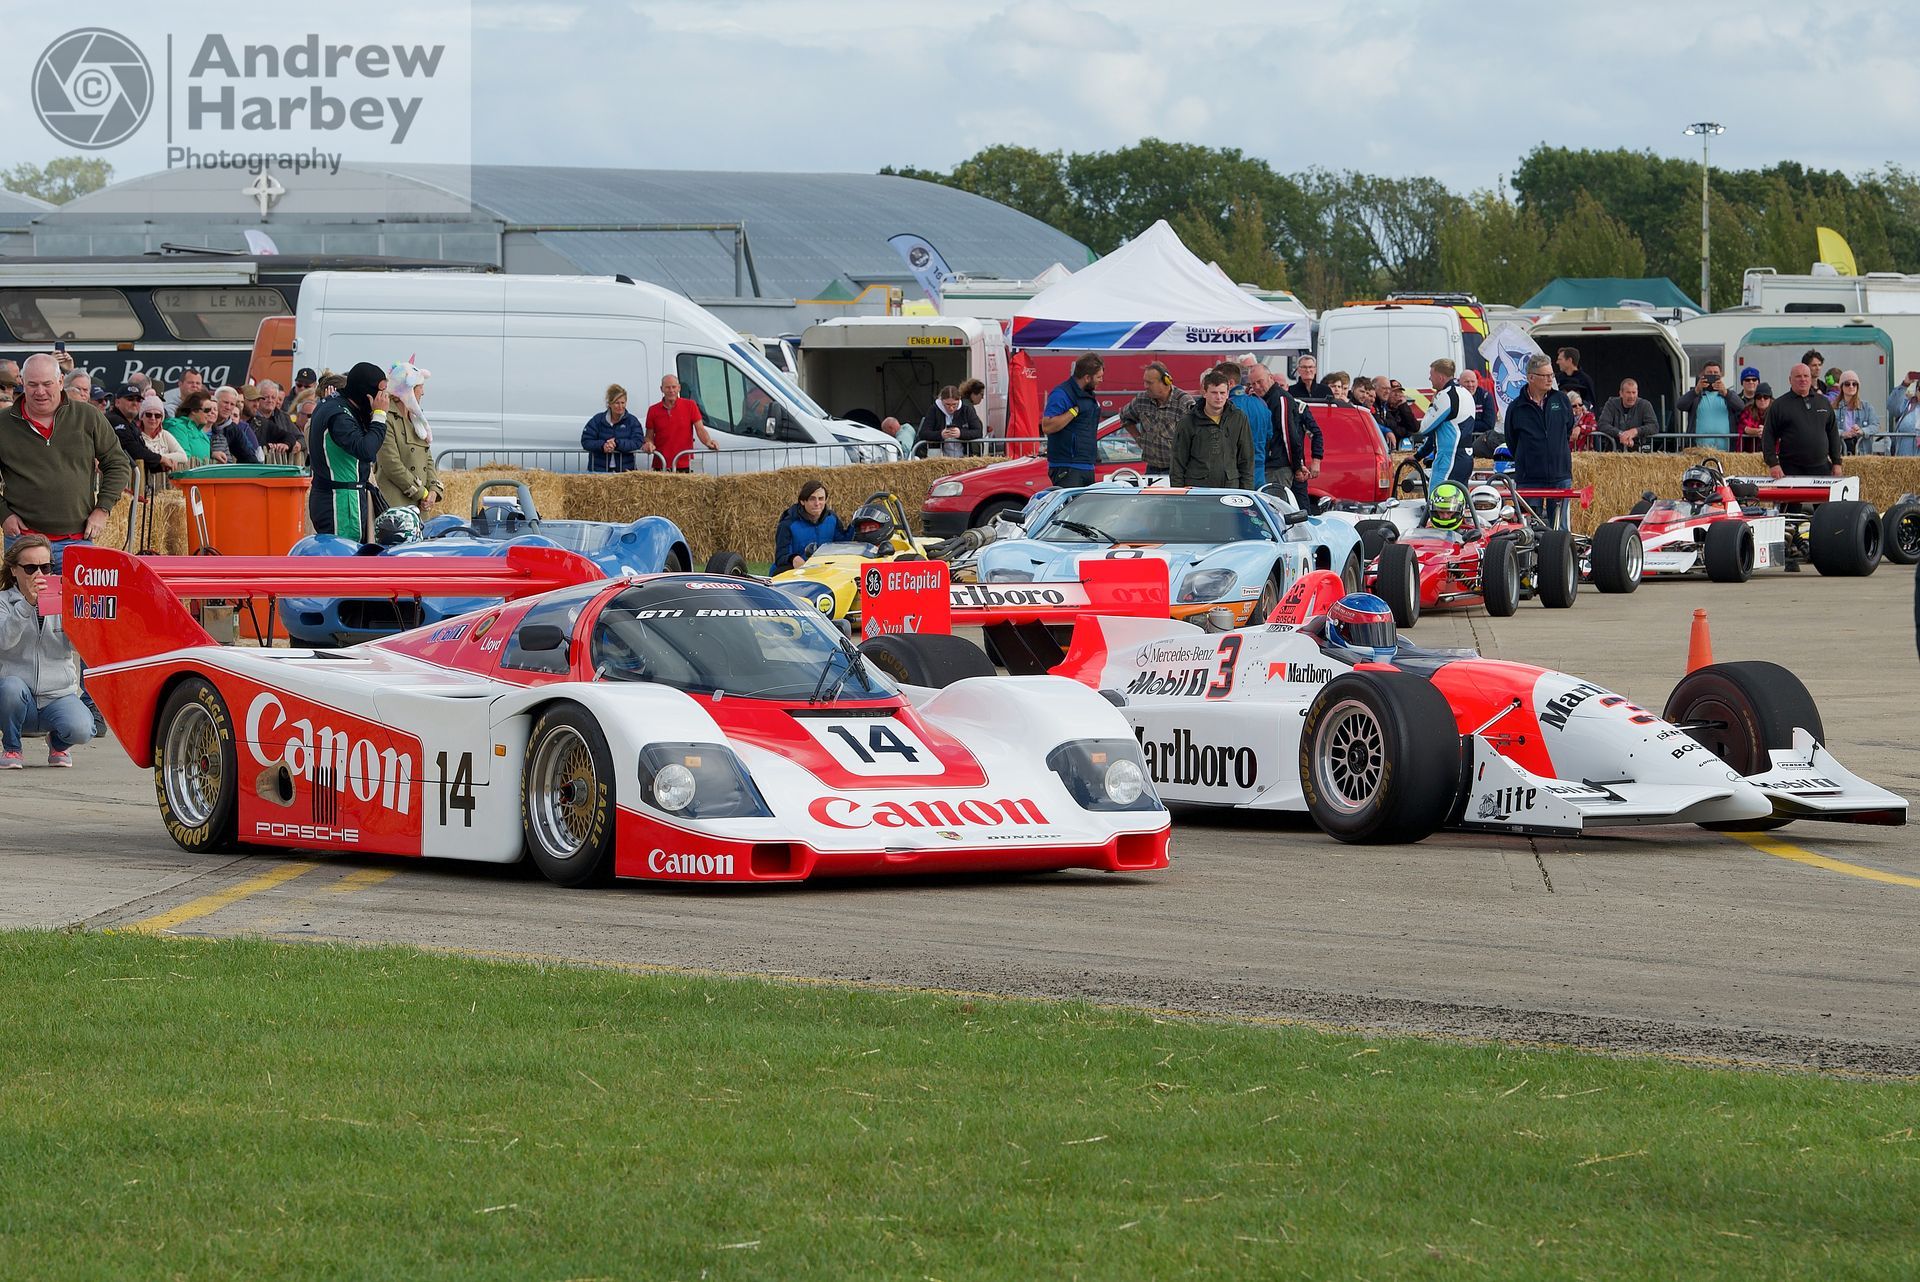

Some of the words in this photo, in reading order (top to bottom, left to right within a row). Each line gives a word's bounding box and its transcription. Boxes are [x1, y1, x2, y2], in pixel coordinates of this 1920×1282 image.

[166, 296, 181, 307] 12
[211, 296, 227, 307] LE
[235, 295, 278, 307] MANS
[911, 337, 931, 345] EN68
[933, 337, 948, 345] XAR
[1186, 333, 1252, 343] SUZUKI
[74, 564, 119, 587] Canon
[888, 571, 902, 591] GE
[903, 570, 941, 594] Capital
[73, 594, 105, 619] Mobil
[950, 585, 1065, 606] rlboro
[695, 610, 821, 619] ENGINEERING
[480, 637, 504, 654] Lloyd
[1150, 646, 1214, 662] Mercedes-Benz
[1205, 633, 1244, 700] 3
[1287, 662, 1333, 684] Marlboro
[1126, 669, 1189, 696] Mobil
[199, 687, 229, 741] EAGLE
[1540, 683, 1607, 732] Marl
[246, 692, 412, 816] Canon
[828, 724, 920, 763] 14
[1671, 743, 1703, 760] BOS
[436, 752, 476, 828] 14
[591, 782, 608, 849] EAGLE
[807, 796, 1051, 830] Canon
[1493, 786, 1537, 821] Lite
[256, 821, 359, 843] PORSCHE
[987, 833, 1062, 841] DUNLOP
[647, 848, 734, 875] Canon
